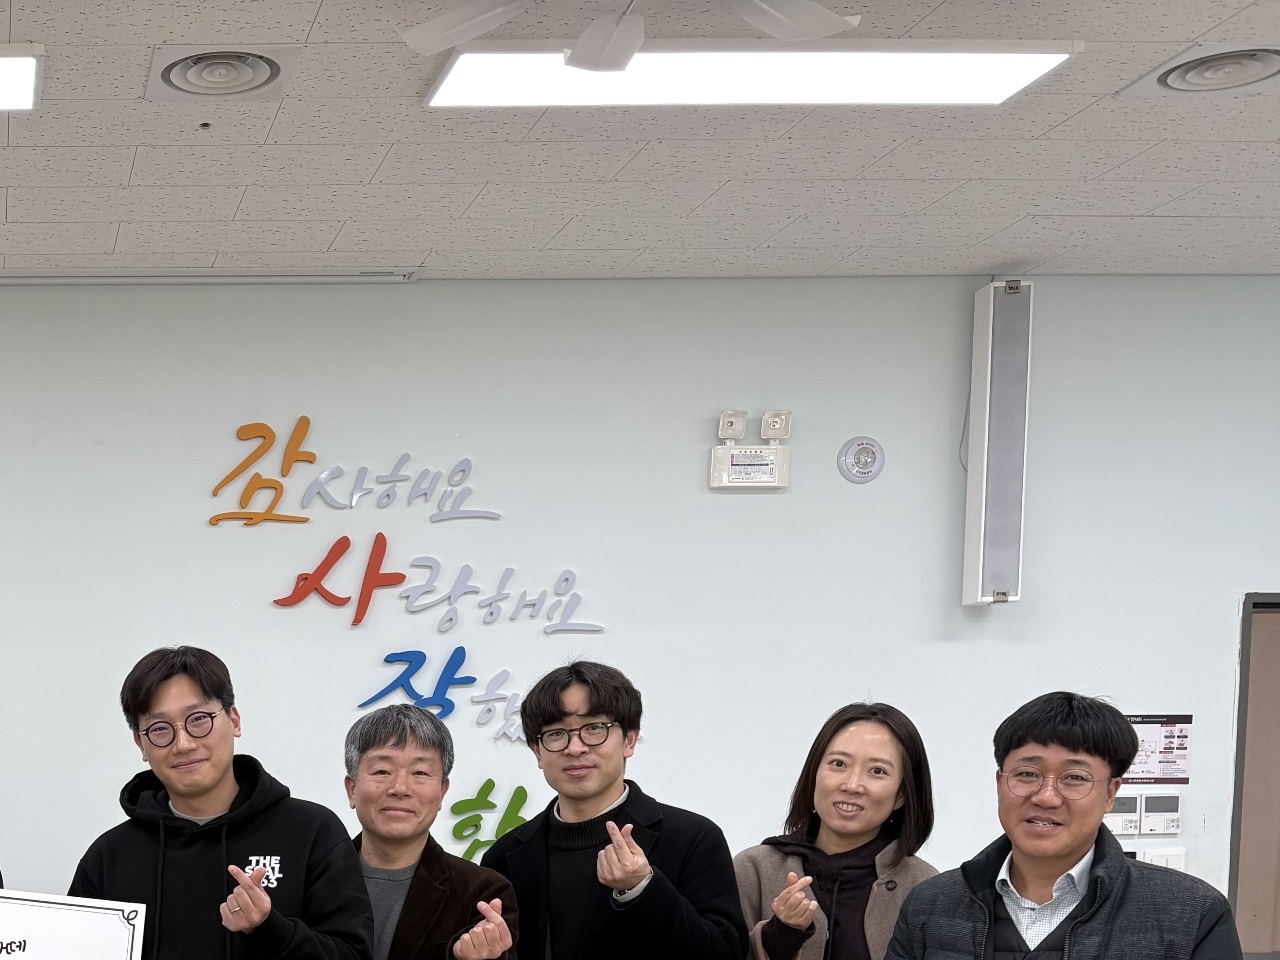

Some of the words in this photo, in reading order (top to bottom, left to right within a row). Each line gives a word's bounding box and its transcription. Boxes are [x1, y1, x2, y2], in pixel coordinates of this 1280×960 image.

[209, 415, 502, 526] 감사해요
[273, 532, 605, 633] 사랑해요
[245, 864, 283, 879] SAL
[248, 855, 281, 868] THE
